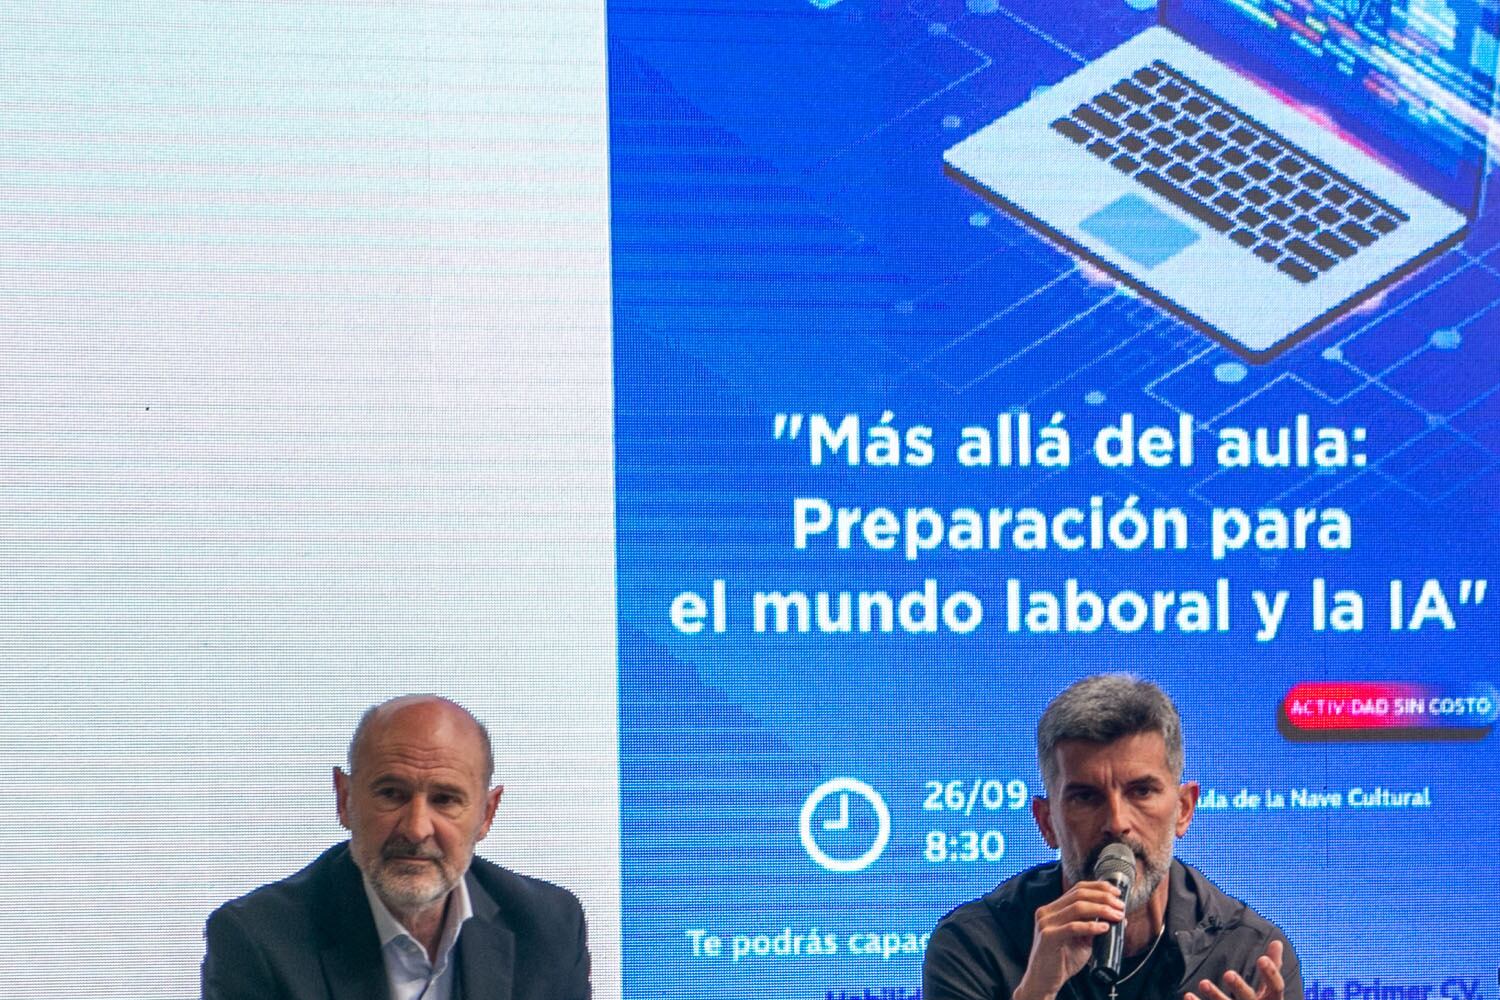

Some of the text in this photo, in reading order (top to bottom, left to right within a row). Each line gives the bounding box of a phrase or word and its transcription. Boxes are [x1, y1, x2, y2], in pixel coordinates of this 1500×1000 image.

[773, 410, 1368, 468] "Más allá del aula:
[793, 495, 1353, 561] Preparación para
[671, 578, 1488, 641] el mundo laboral y la IA"
[1290, 697, 1492, 716] ACTIVDAD SIN COSTO
[922, 779, 1029, 817] 26/09
[1197, 788, 1228, 809] ula
[1232, 788, 1262, 808] de
[1265, 788, 1285, 808] la
[1291, 788, 1343, 808] Nave
[924, 830, 1006, 861] 8:30
[684, 927, 931, 961] Te podrás capac
